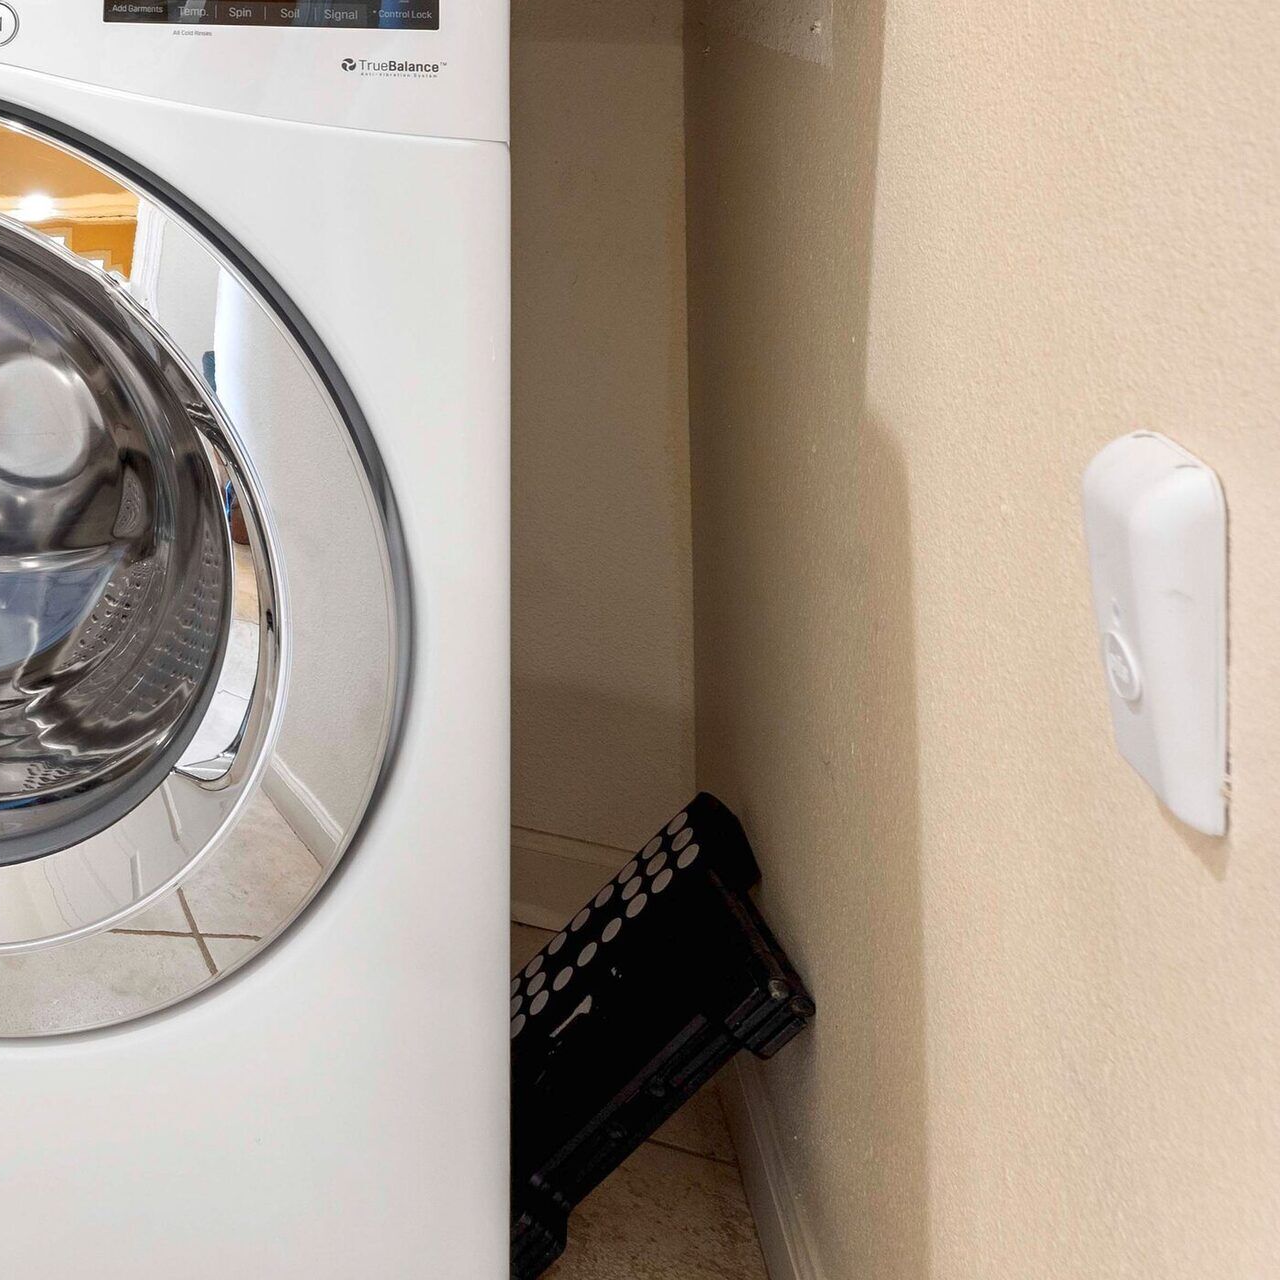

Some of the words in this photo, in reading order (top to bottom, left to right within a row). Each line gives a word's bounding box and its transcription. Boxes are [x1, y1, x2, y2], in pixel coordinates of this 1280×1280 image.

[178, 6, 208, 18] Temp.
[229, 7, 252, 19] Spin
[281, 8, 300, 18] Soil
[324, 9, 358, 21] Signal
[378, 9, 410, 18] Control
[412, 10, 432, 19] Lock
